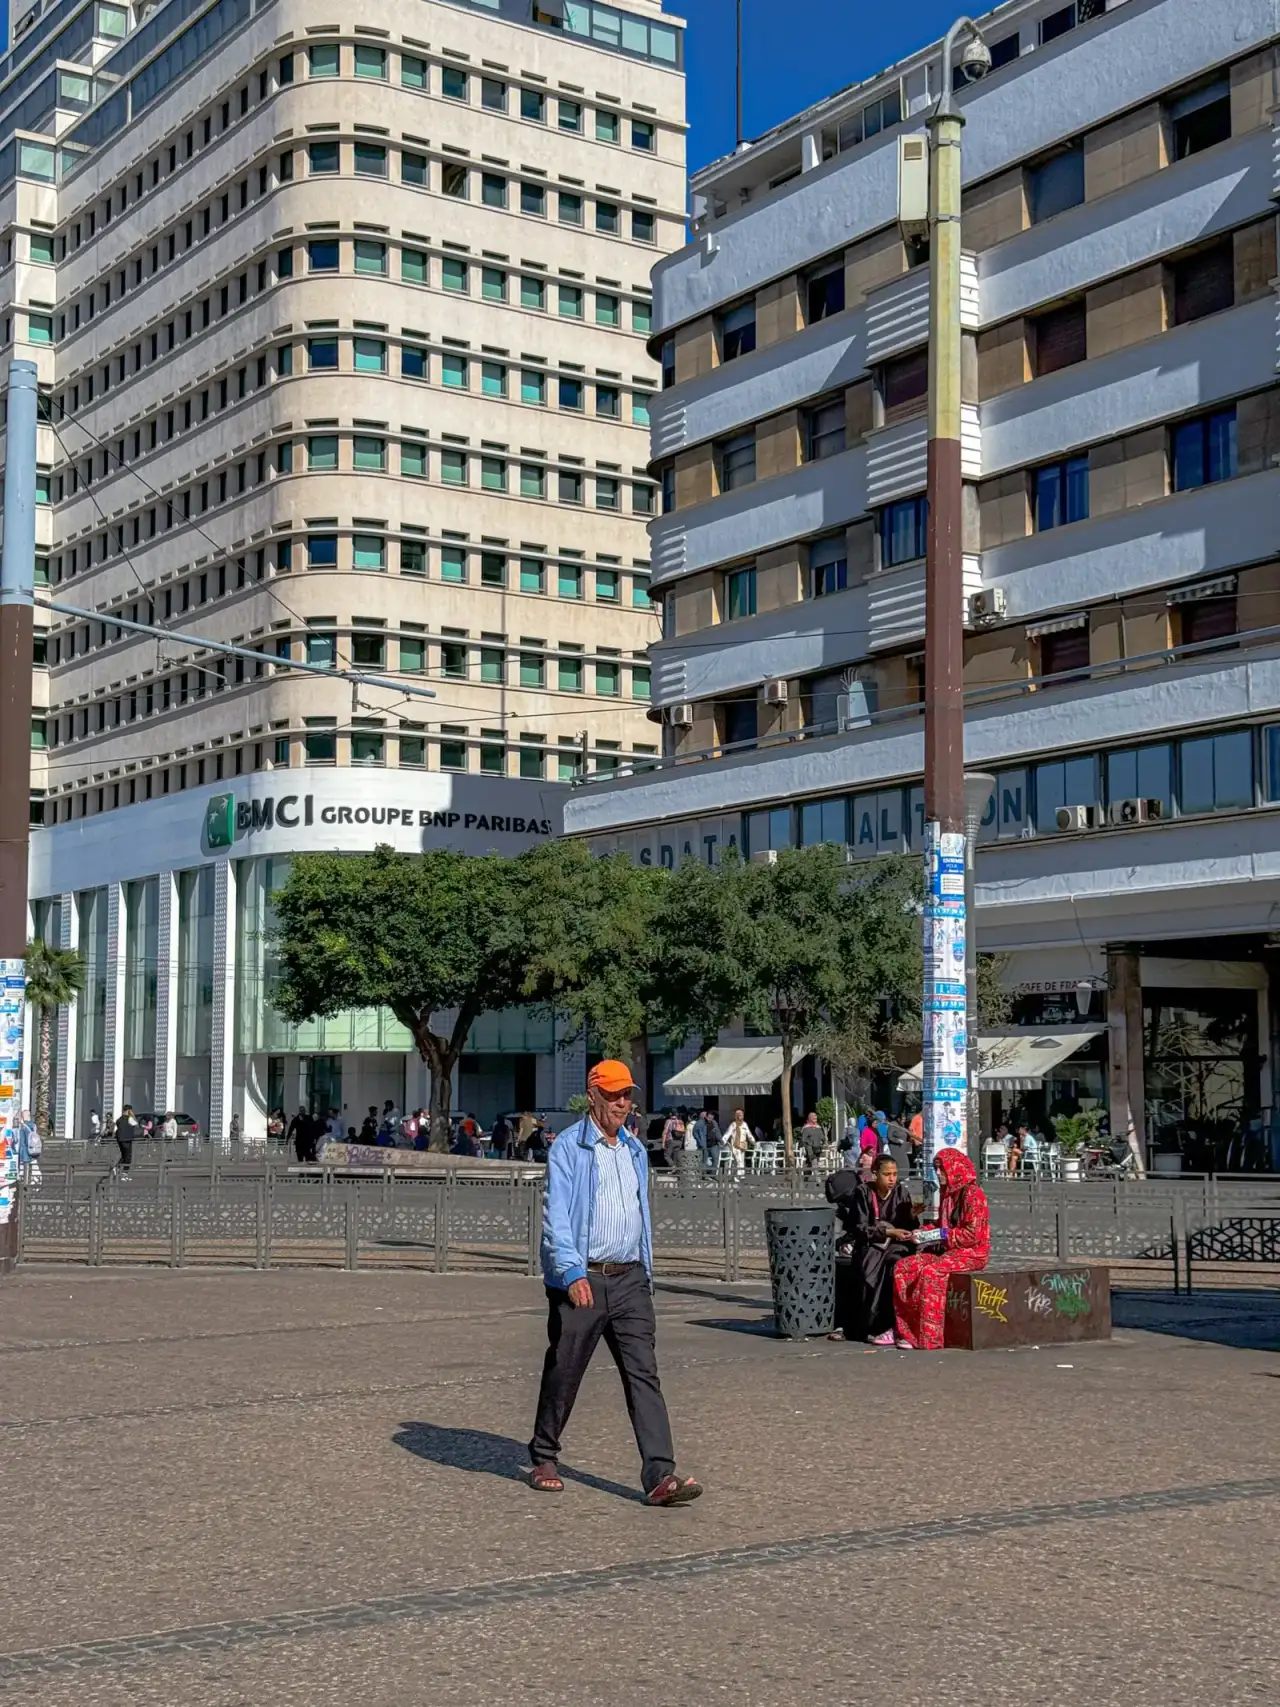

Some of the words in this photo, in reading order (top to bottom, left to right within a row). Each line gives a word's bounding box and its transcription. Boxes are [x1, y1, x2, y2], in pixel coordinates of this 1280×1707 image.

[237, 794, 314, 830] BMCI
[321, 806, 414, 826] GROUPE
[419, 810, 460, 828] BNP
[464, 813, 552, 835] PARIBAS
[1044, 981, 1057, 991] DE
[1059, 979, 1097, 990] FRAE
